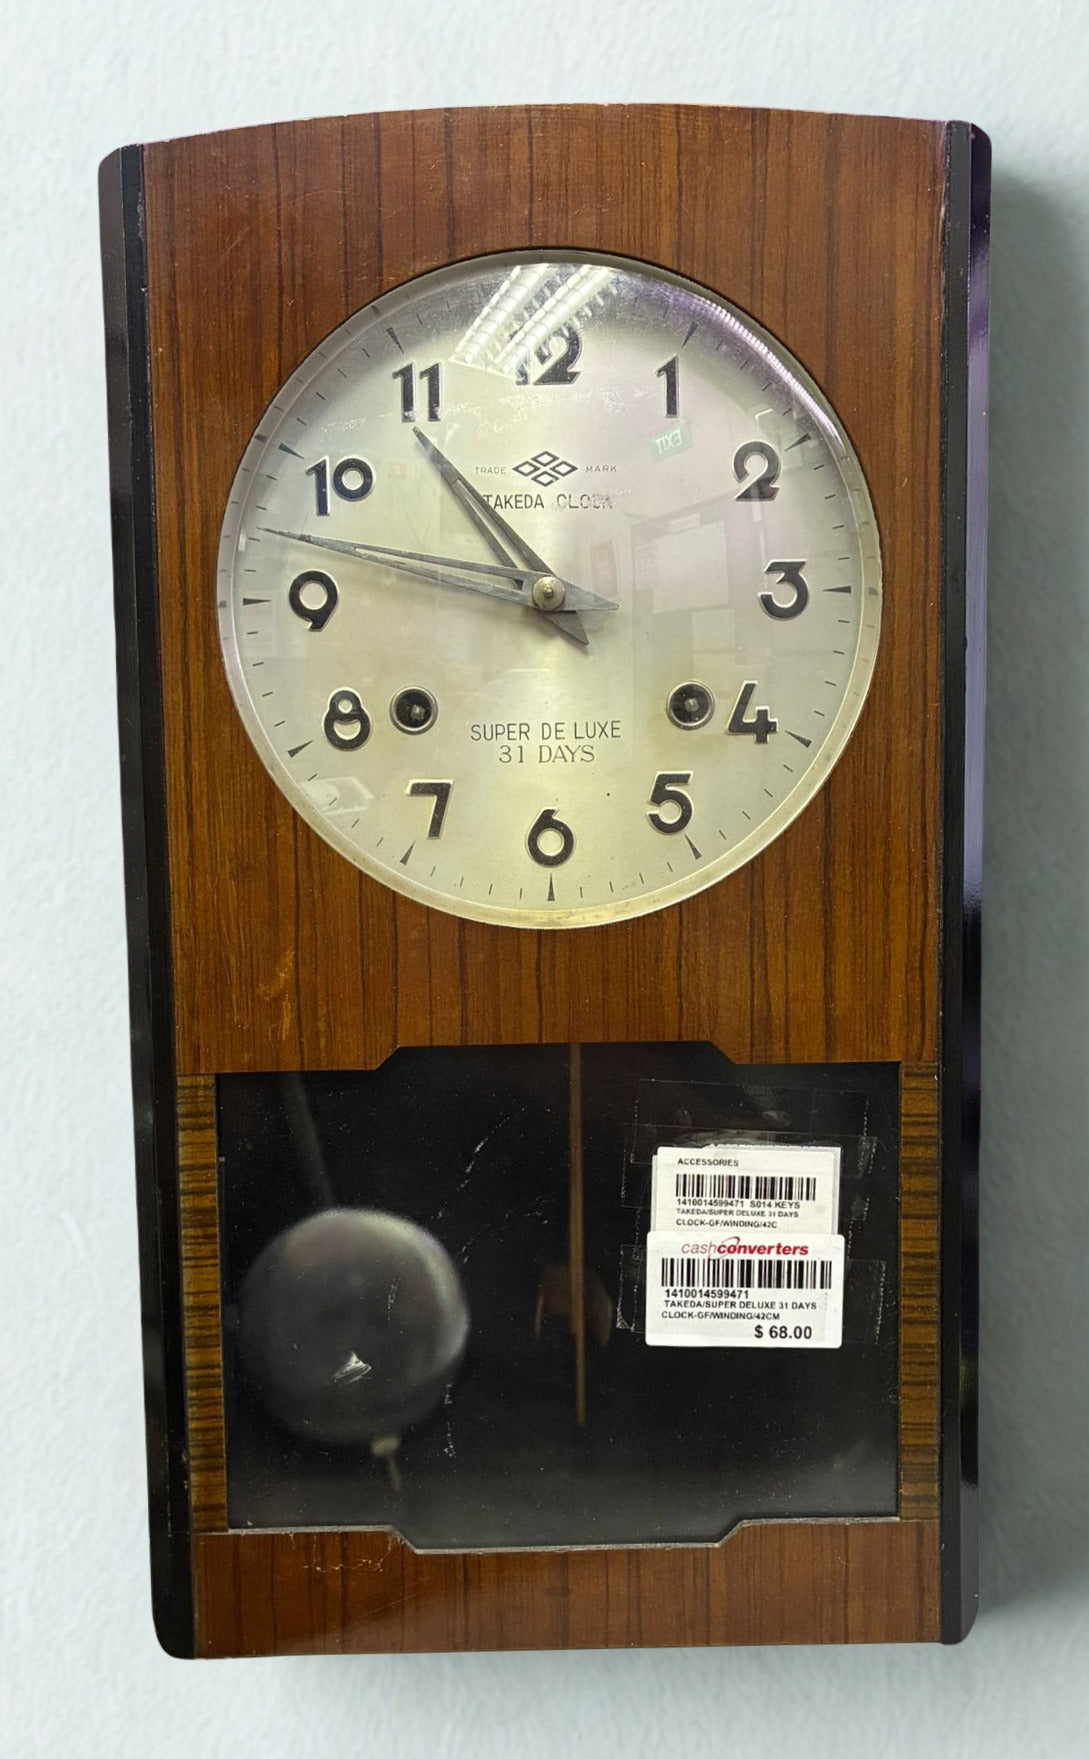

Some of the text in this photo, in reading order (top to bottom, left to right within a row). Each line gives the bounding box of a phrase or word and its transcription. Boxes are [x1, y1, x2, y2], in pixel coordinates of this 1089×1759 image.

[391, 361, 442, 423] 11
[655, 354, 680, 419] 1
[474, 466, 507, 475] TRADE
[585, 464, 618, 473] MARK
[733, 440, 781, 502] 2
[304, 456, 376, 517] 10
[483, 494, 545, 510] TAKEDA
[758, 557, 810, 621] 3
[288, 569, 339, 632] 9
[322, 686, 372, 752] 8
[726, 680, 779, 744] 4
[470, 720, 622, 742] SUPER DE LUXE
[499, 744, 596, 764] 31 DAYS
[405, 778, 454, 840] 7
[646, 770, 694, 834] 5
[526, 808, 576, 869] 6
[677, 1158, 739, 1167] ACCESSORIES
[676, 1208, 735, 1216] TAKEDA/SUPER
[736, 1210, 766, 1218] DELUXE
[777, 1210, 800, 1219] DAYS
[677, 1198, 801, 1210] 1410014599471 S014 KEYS
[664, 1299, 818, 1310] TAKEDA/SUPER DELUXE 31 DAYS
[665, 1288, 750, 1299] 1410014599471
[661, 1310, 781, 1321] CLOCK-GF/WINDING/42CM
[768, 1325, 813, 1340] 68.00
